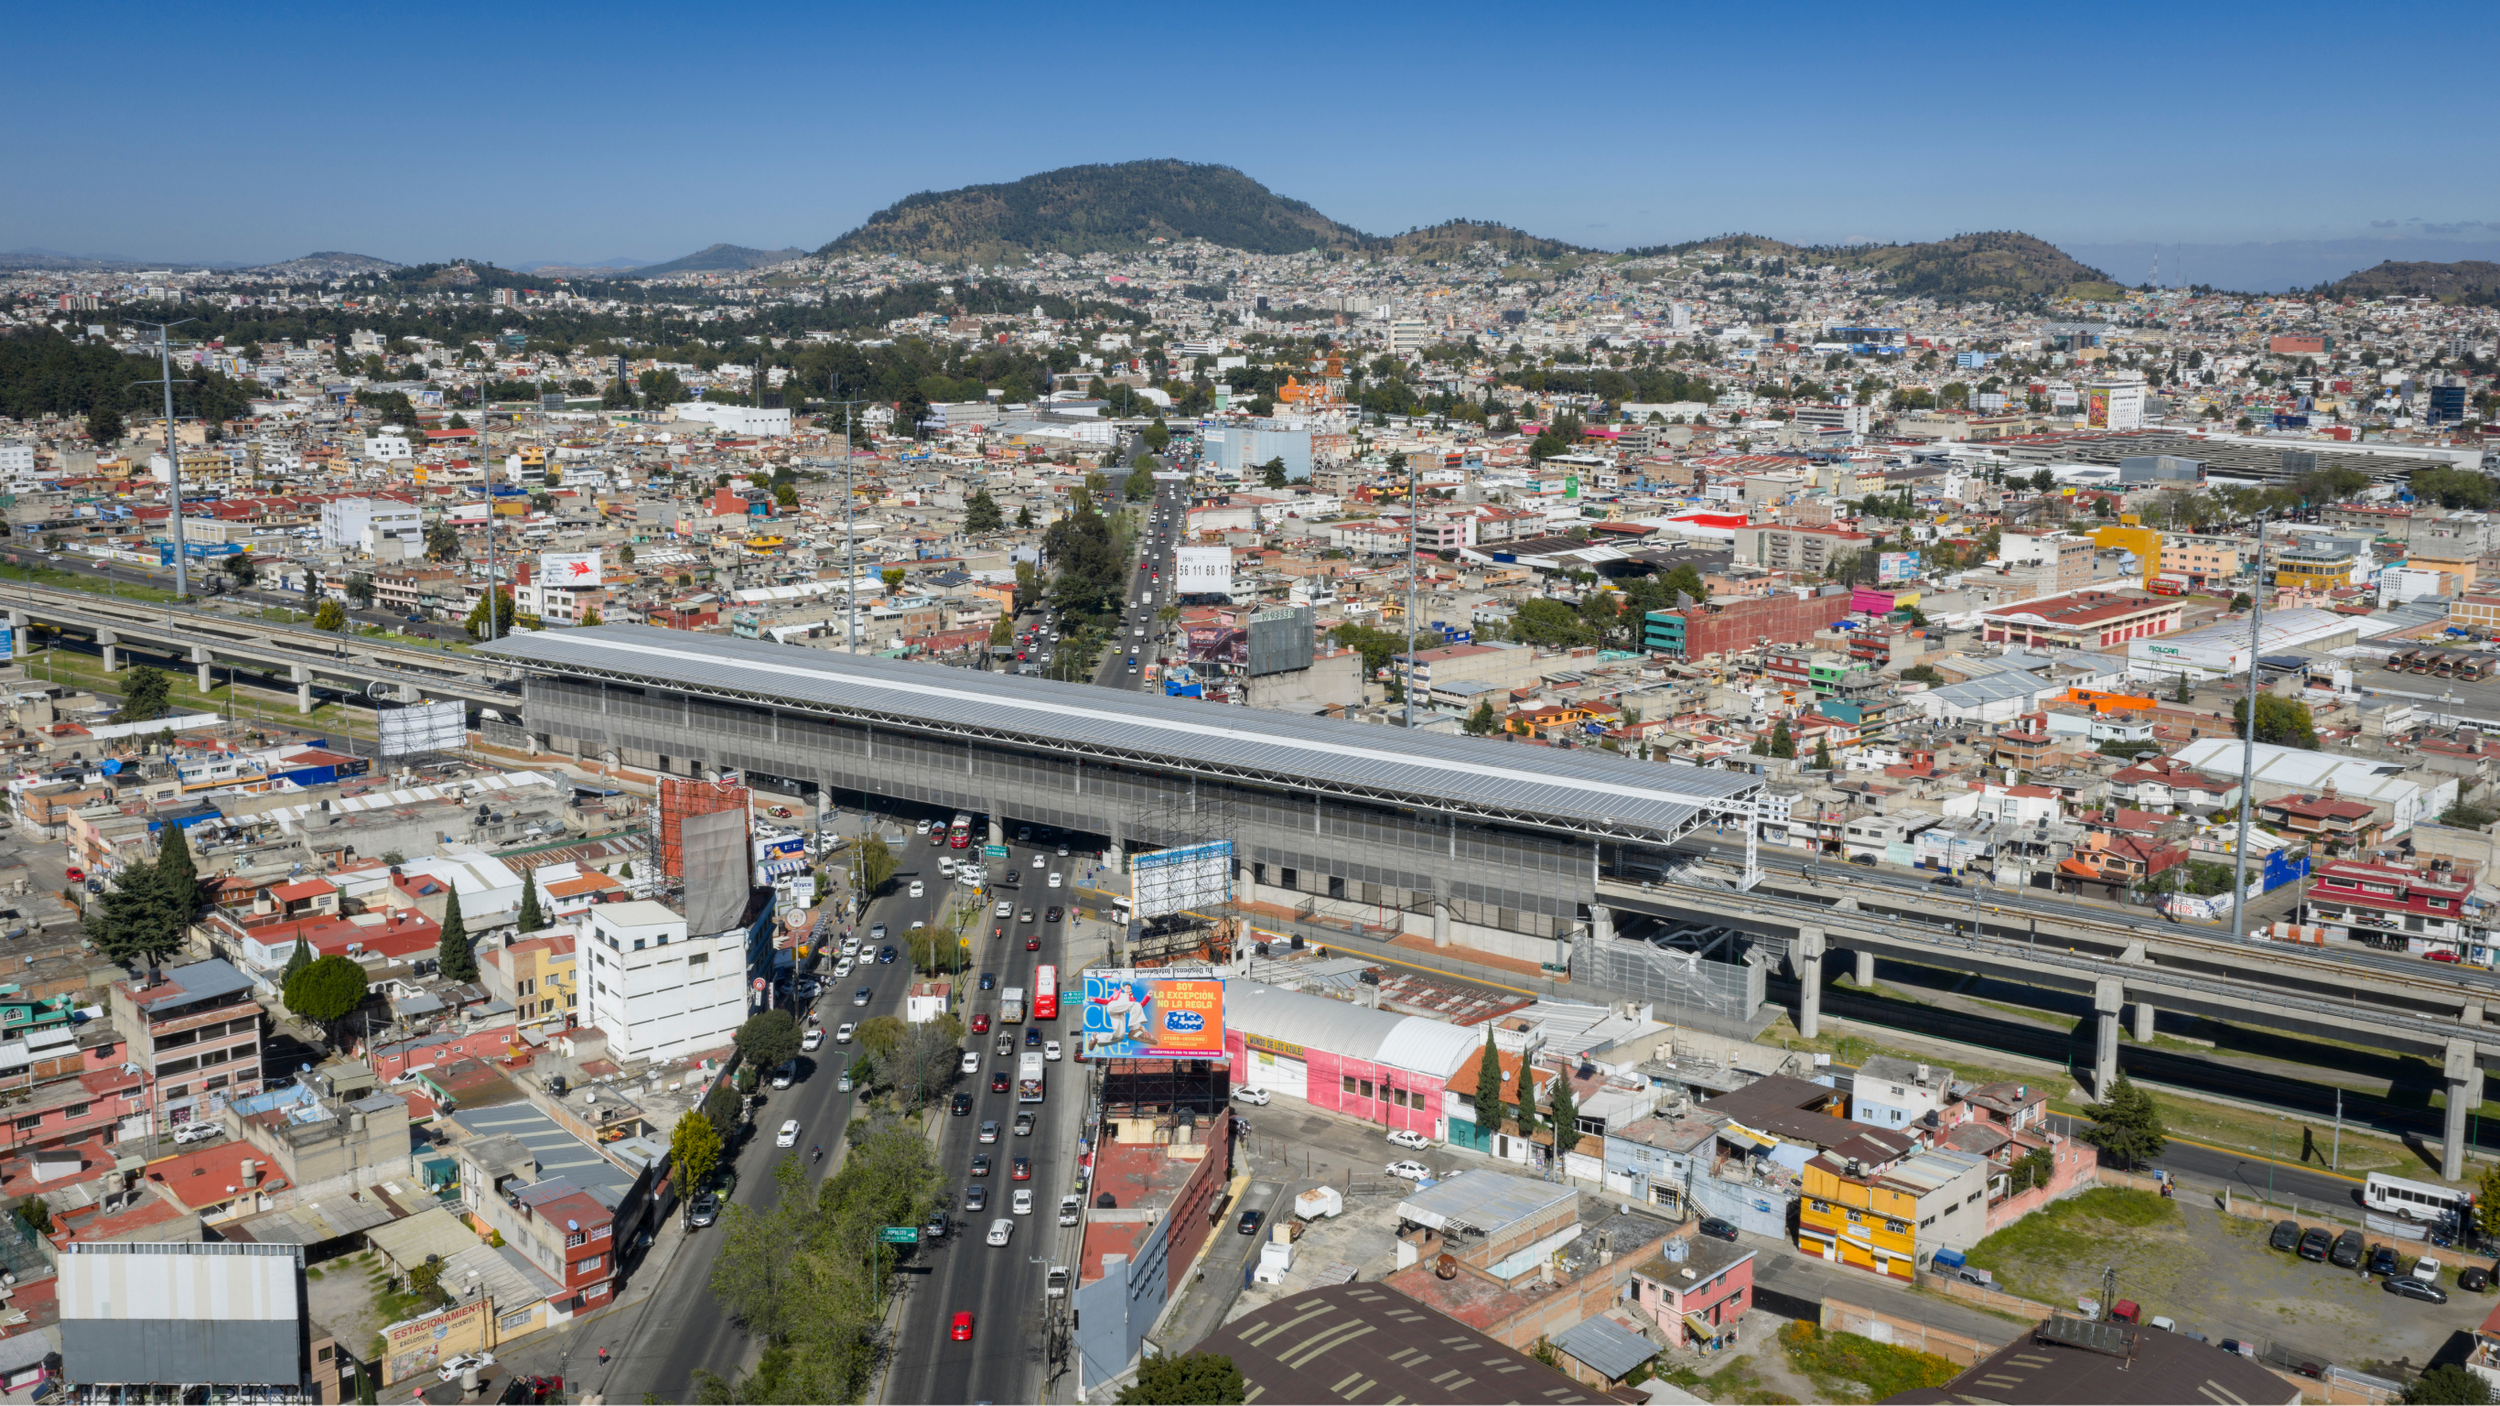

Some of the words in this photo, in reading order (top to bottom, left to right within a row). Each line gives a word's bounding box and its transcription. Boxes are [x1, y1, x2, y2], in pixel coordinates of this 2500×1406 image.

[1179, 564, 1189, 576] 56
[1193, 565, 1202, 576] 11
[1205, 564, 1216, 576] 68
[1219, 564, 1229, 576] 17
[2148, 645, 2179, 656] ROLCAR
[1176, 983, 1193, 991] SOY
[1154, 991, 1164, 999] LA
[1169, 990, 1216, 1001] EXCEPCIÓN,
[1185, 1001, 1212, 1009] REGLA
[1168, 1011, 1201, 1022] Price
[1167, 1019, 1204, 1031] Shoes
[394, 1300, 489, 1340] ESTACIONAMIENTO
[400, 1332, 430, 1348] EXCLUSIVO
[451, 1316, 476, 1330] CLIENTES
